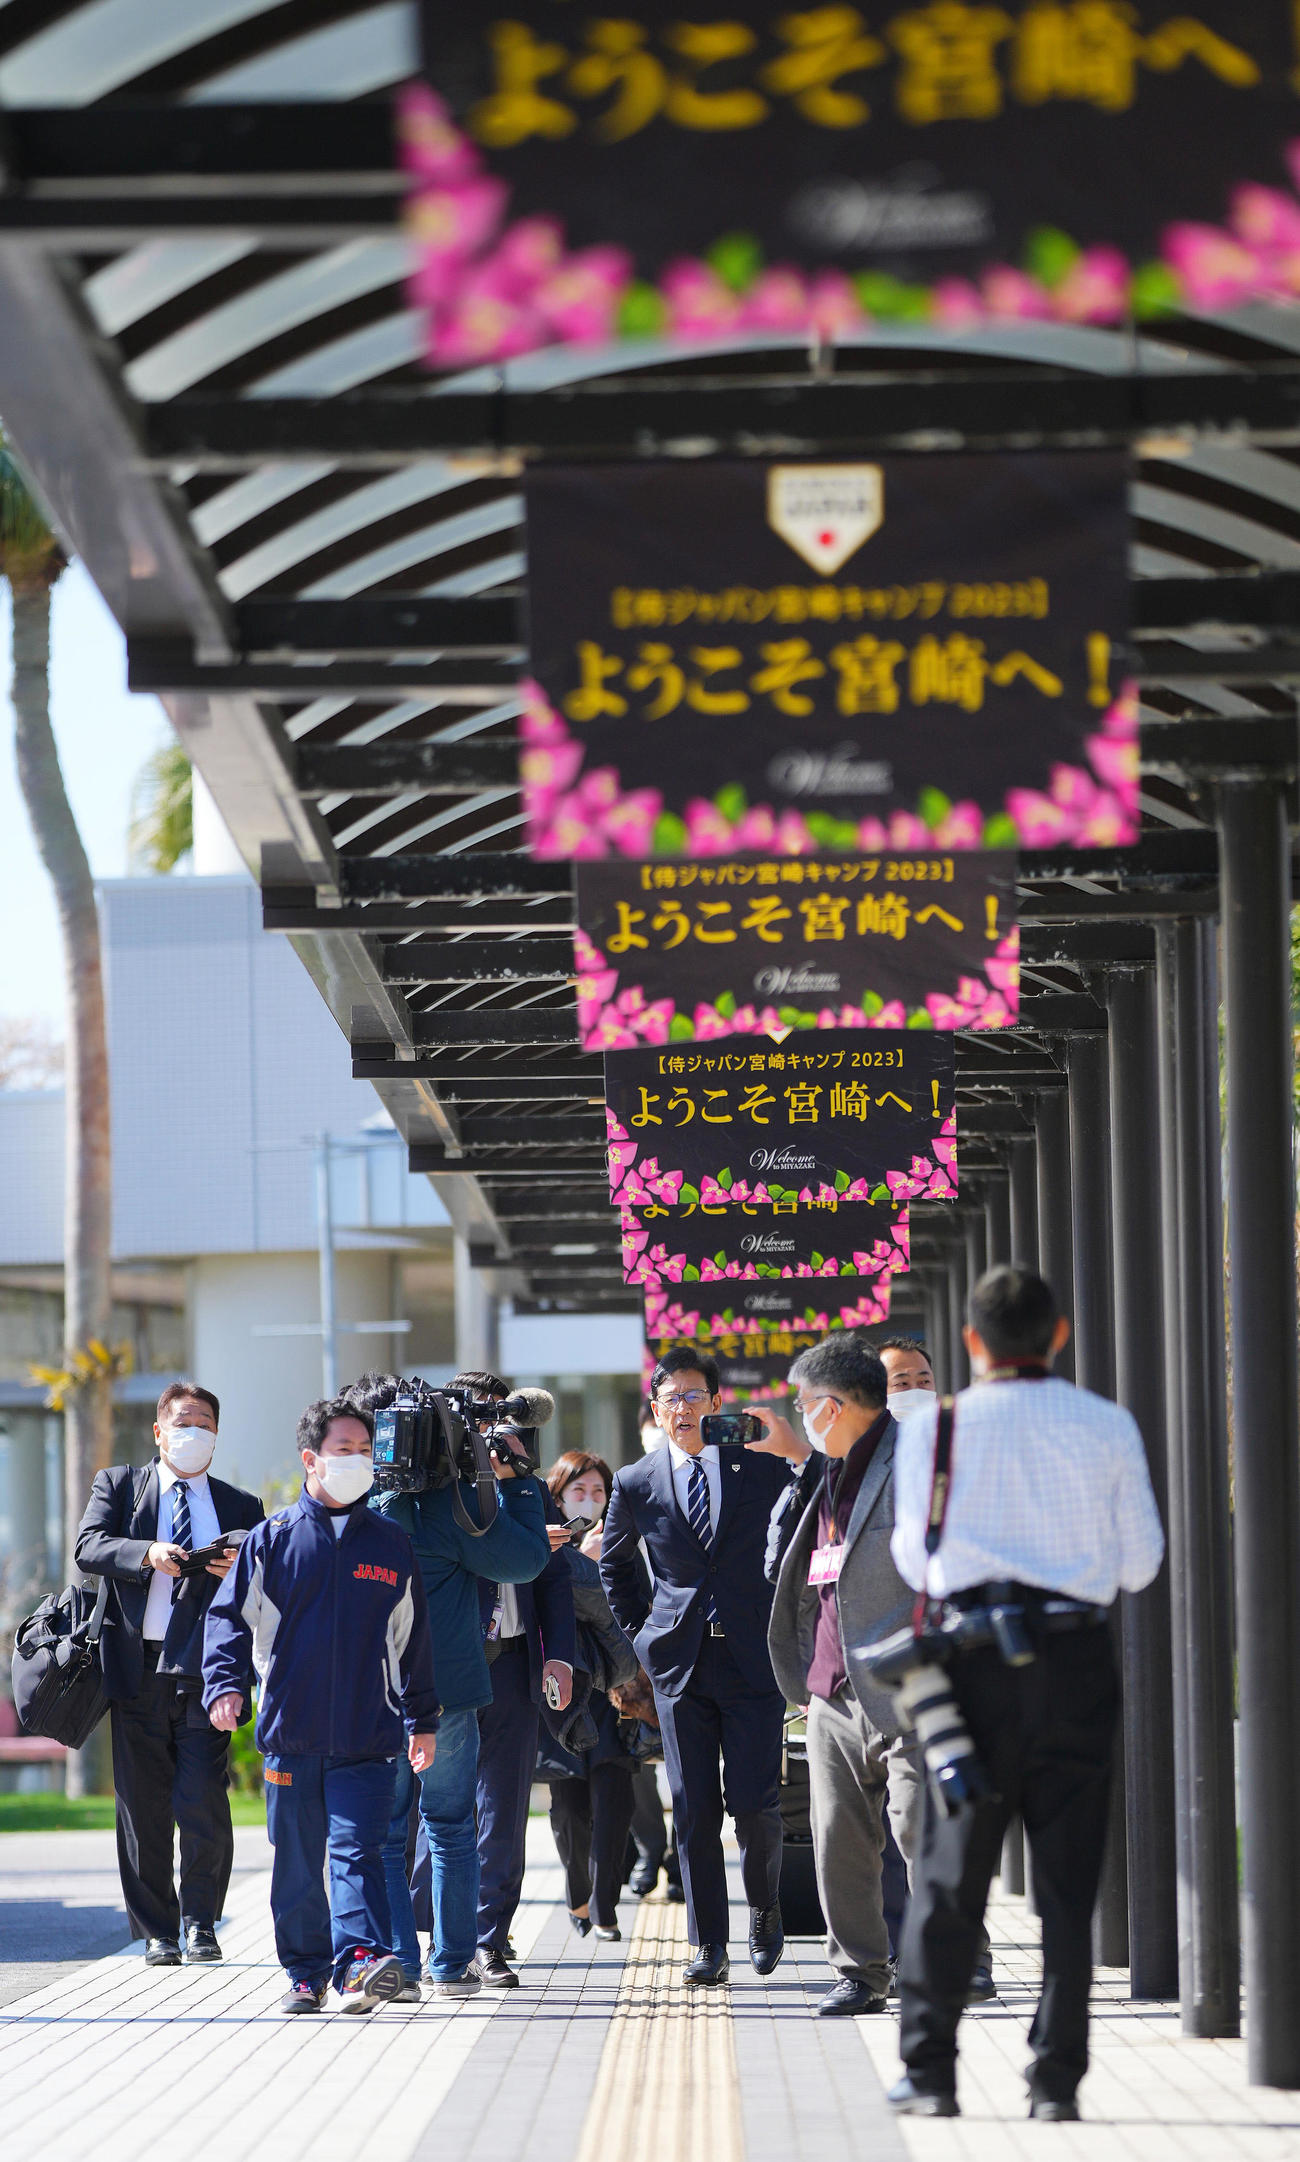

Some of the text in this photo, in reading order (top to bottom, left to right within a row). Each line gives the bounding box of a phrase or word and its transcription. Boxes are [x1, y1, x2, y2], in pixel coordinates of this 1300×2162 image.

[472, 0, 1300, 143] ようこそ宮崎へ
[658, 1050, 846, 1074] 【侍ジャパン宮崎キャンプ
[630, 1079, 940, 1127] ようこそ宮崎へ！
[749, 1144, 816, 1171] Welcome
[781, 1162, 816, 1170] MIYAZAKI
[740, 1231, 795, 1252] Welcome
[353, 1563, 398, 1587] JAPAN
[265, 1767, 293, 1787] JAPAN
